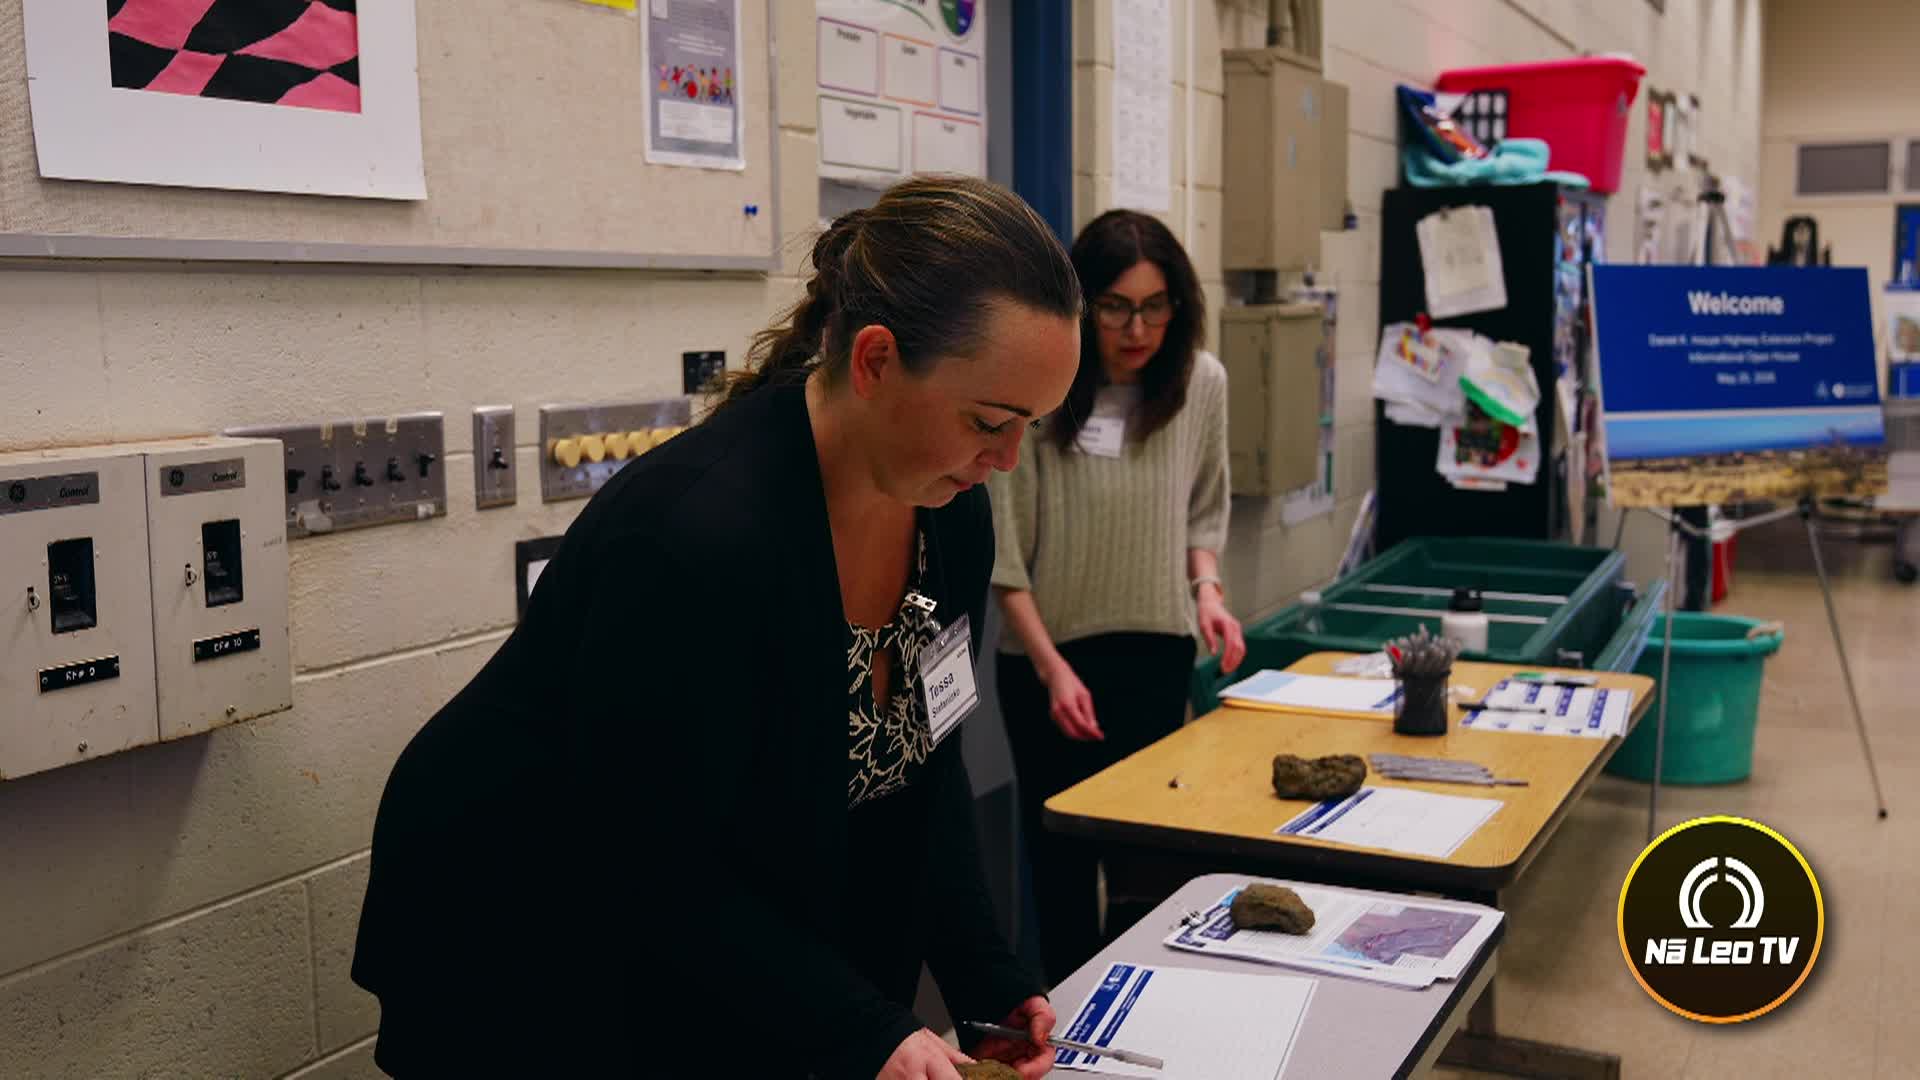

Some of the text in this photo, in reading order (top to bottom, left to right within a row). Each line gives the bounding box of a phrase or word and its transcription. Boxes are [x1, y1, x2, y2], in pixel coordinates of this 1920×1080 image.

[1688, 291, 1784, 315] Welcome
[212, 471, 240, 483] Control
[59, 487, 89, 499] Control
[929, 672, 954, 701] Tessa
